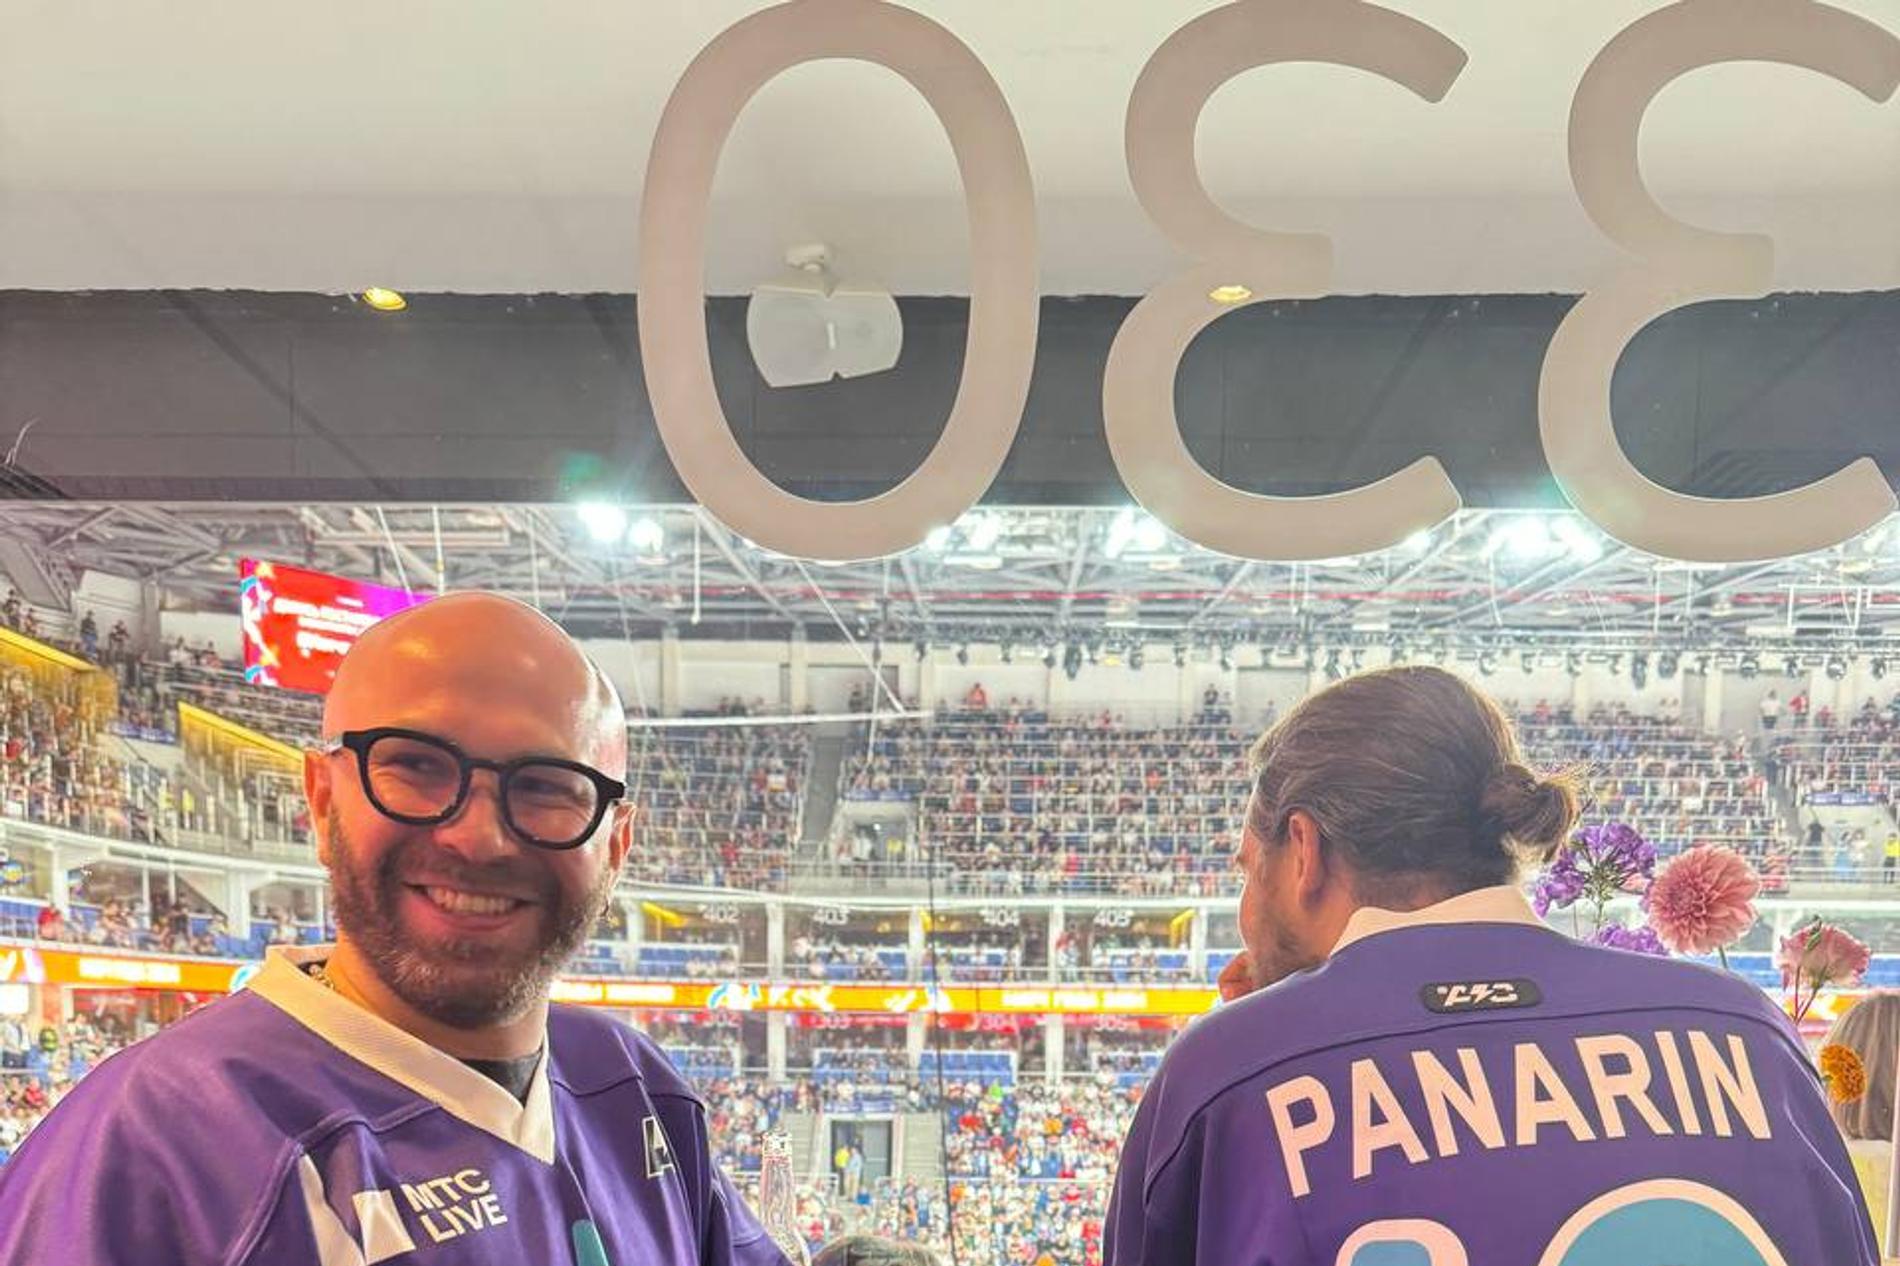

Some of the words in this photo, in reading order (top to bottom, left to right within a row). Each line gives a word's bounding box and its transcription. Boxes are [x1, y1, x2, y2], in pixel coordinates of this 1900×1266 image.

[703, 903, 739, 924] 402
[813, 906, 850, 925] 403
[1265, 1031, 1771, 1198] PANARIN
[421, 1194, 508, 1243] LIVE
